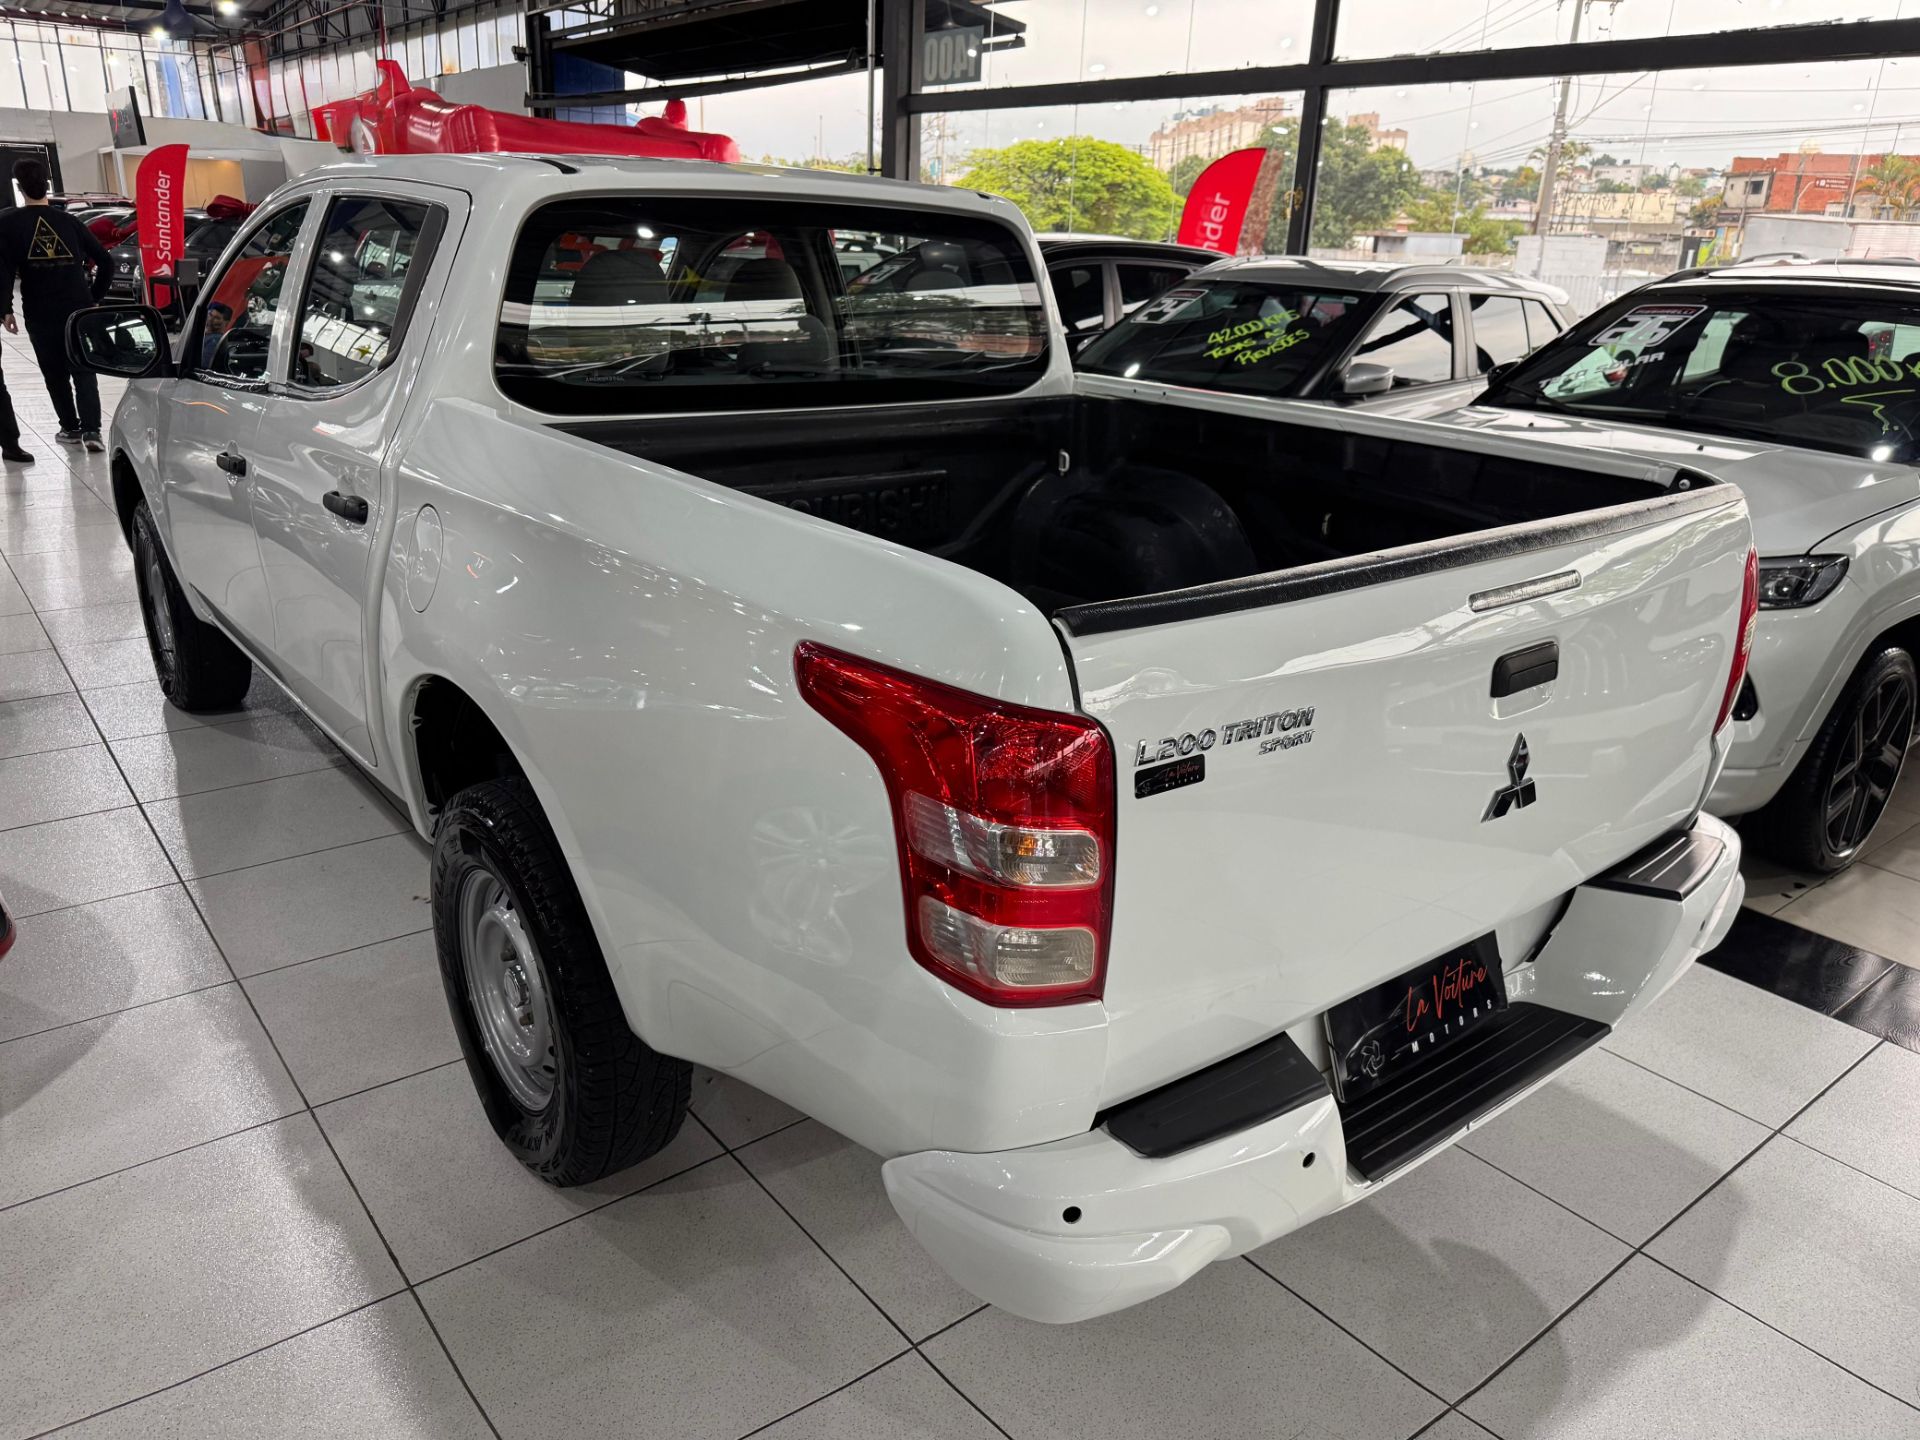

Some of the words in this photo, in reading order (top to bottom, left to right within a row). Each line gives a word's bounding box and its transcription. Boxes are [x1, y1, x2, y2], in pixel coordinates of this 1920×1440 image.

[154, 170, 171, 261] Santander
[1207, 319, 1264, 345] 42.000
[1596, 316, 1684, 344] 26
[1594, 352, 1666, 374] SOLAR
[1771, 354, 1904, 395] 8.000
[1134, 728, 1217, 767] L200
[1222, 706, 1316, 746] TRITON
[1259, 729, 1316, 755] SPORT
[1433, 958, 1488, 1019] Voiture
[1411, 999, 1492, 1053] MOTORS
